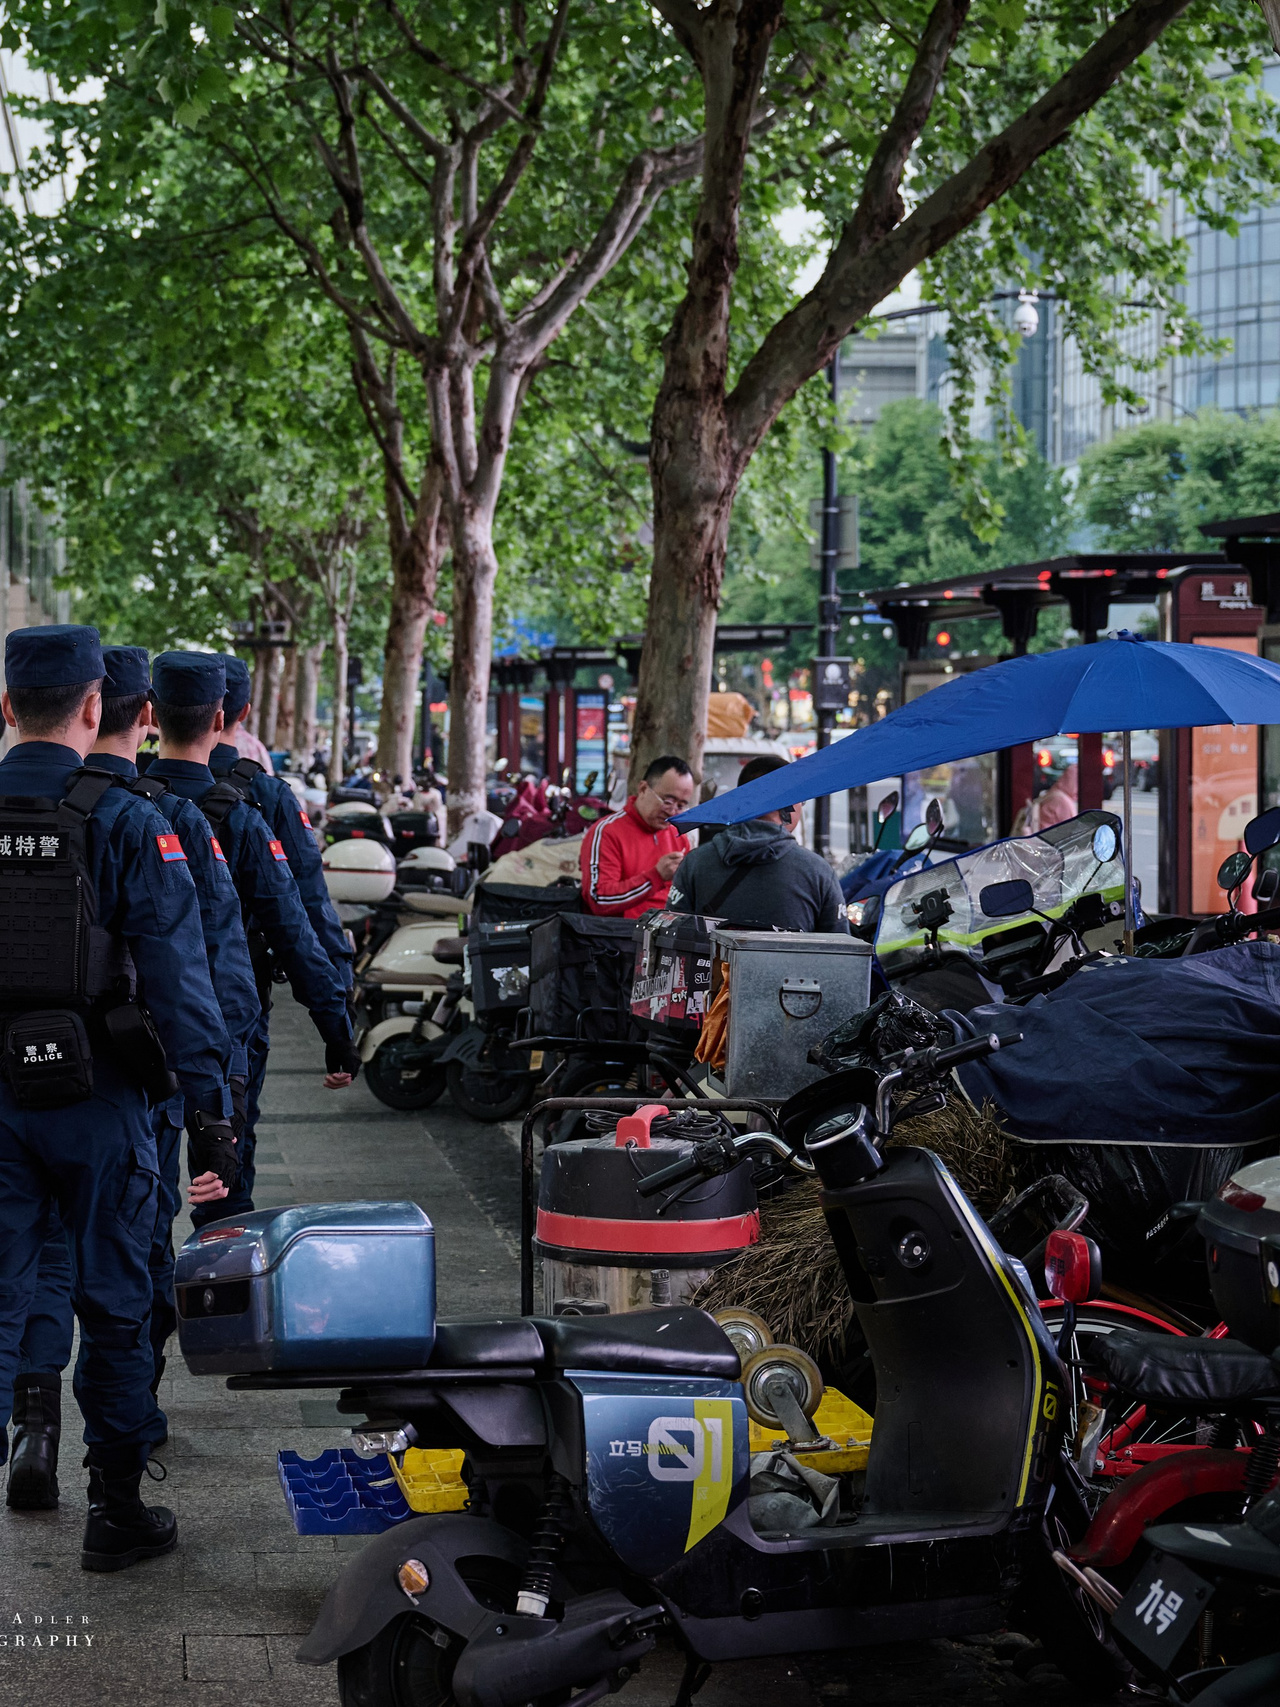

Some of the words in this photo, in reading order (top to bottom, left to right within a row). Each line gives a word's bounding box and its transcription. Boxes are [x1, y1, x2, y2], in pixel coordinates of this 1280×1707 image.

[25, 1042, 58, 1056] 警察
[23, 1052, 63, 1064] POLICE
[609, 1440, 642, 1457] 立马
[648, 1416, 722, 1482] 01
[1135, 1579, 1184, 1635] 九号
